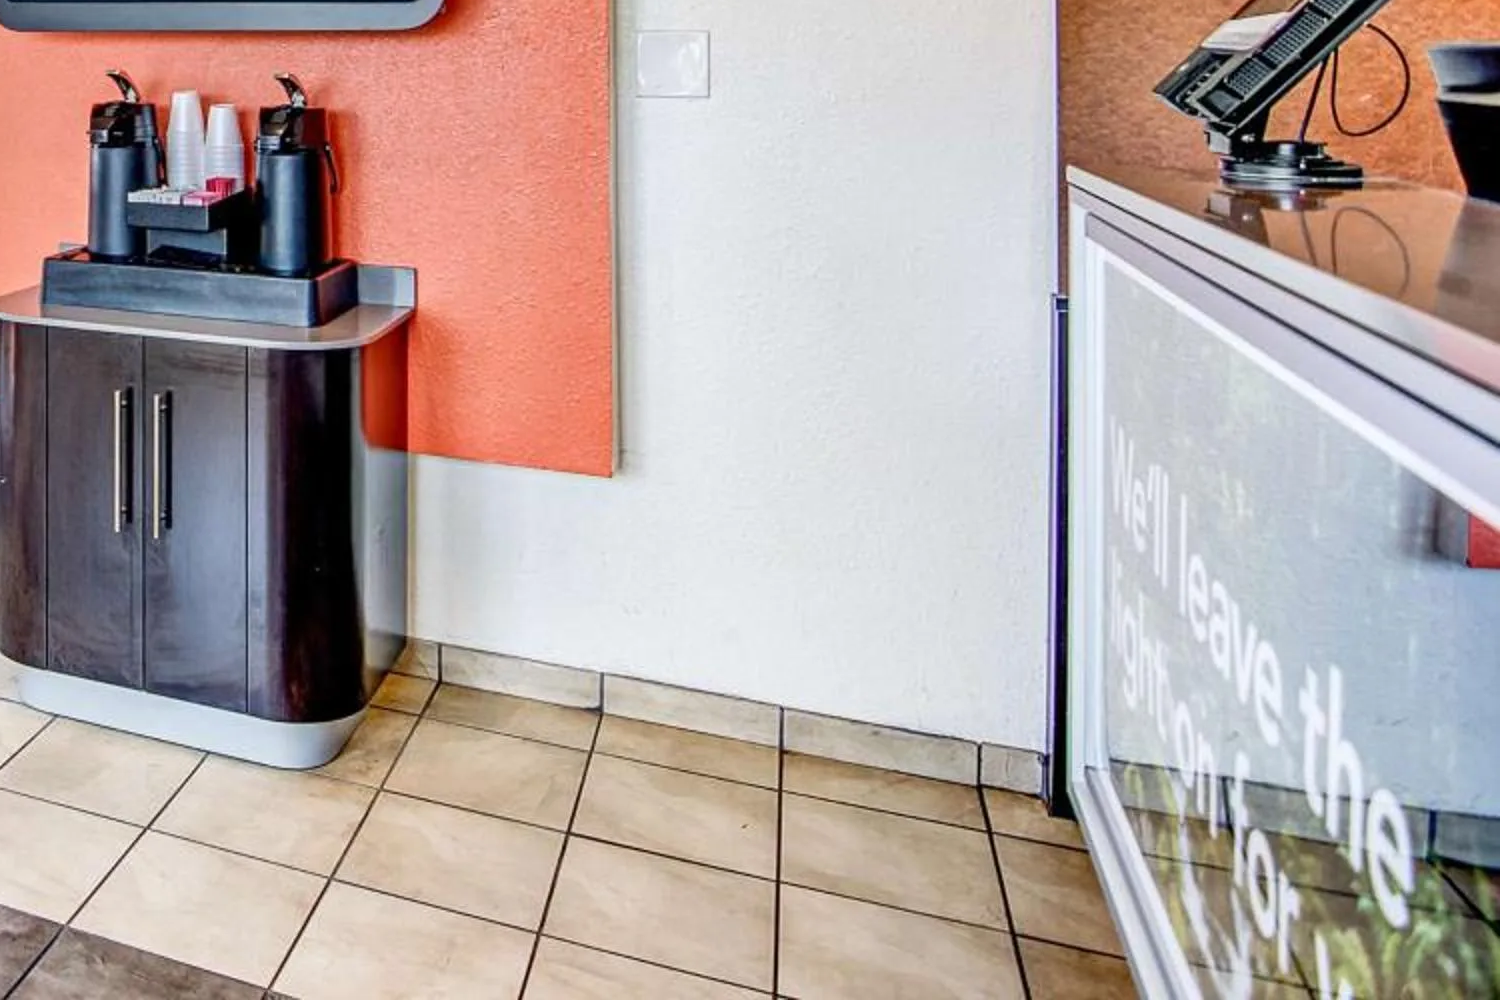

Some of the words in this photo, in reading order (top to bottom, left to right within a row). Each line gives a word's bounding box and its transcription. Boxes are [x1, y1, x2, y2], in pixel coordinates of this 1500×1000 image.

[1109, 414, 1169, 590] We'll
[1179, 493, 1283, 748] leave
[1301, 664, 1415, 929] the
[1110, 546, 1169, 743] light
[1174, 700, 1217, 839] on
[1230, 751, 1301, 974] for
